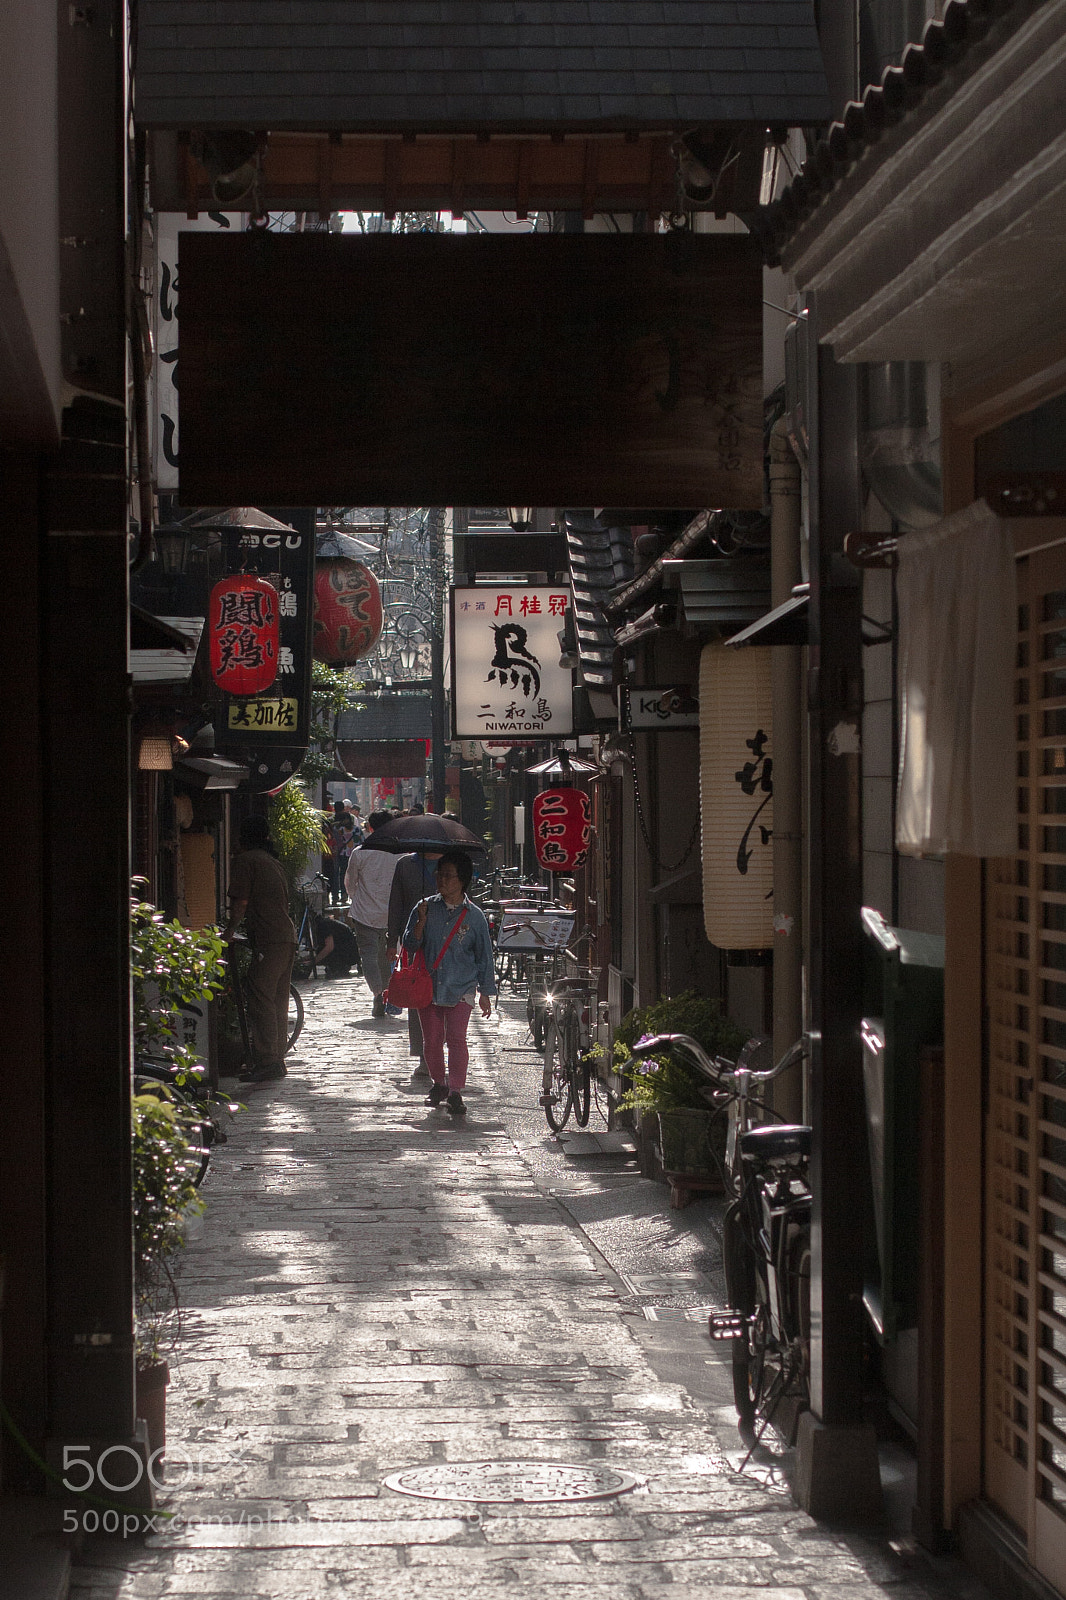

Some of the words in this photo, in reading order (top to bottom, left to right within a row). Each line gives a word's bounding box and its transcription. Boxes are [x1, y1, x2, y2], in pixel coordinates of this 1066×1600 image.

[330, 566, 371, 652] ほてい
[494, 594, 568, 617] 月桂冠
[476, 698, 553, 722] 二和鳥
[485, 722, 544, 731] NIWATORI
[538, 795, 569, 864] 二和鳥
